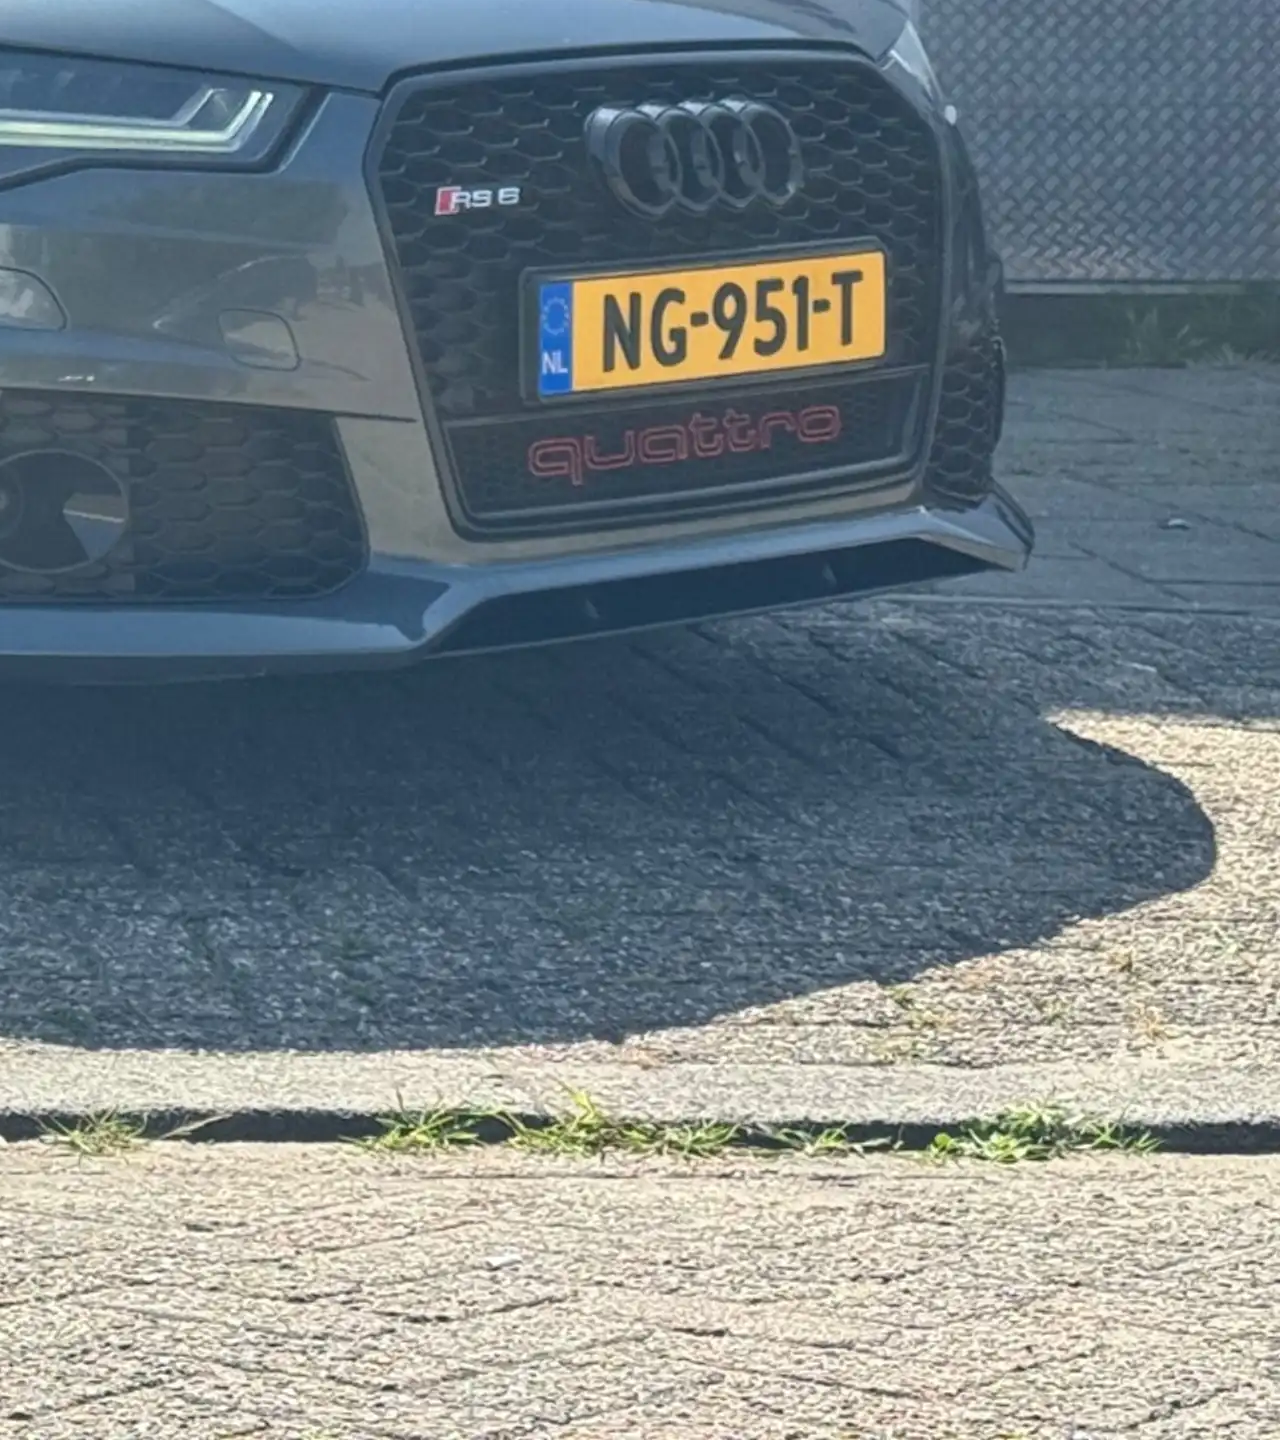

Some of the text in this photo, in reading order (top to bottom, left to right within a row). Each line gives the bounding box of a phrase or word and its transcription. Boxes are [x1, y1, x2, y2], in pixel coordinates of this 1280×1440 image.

[602, 270, 864, 373] NG-951-T
[541, 349, 569, 376] NL
[528, 406, 841, 485] quattro
